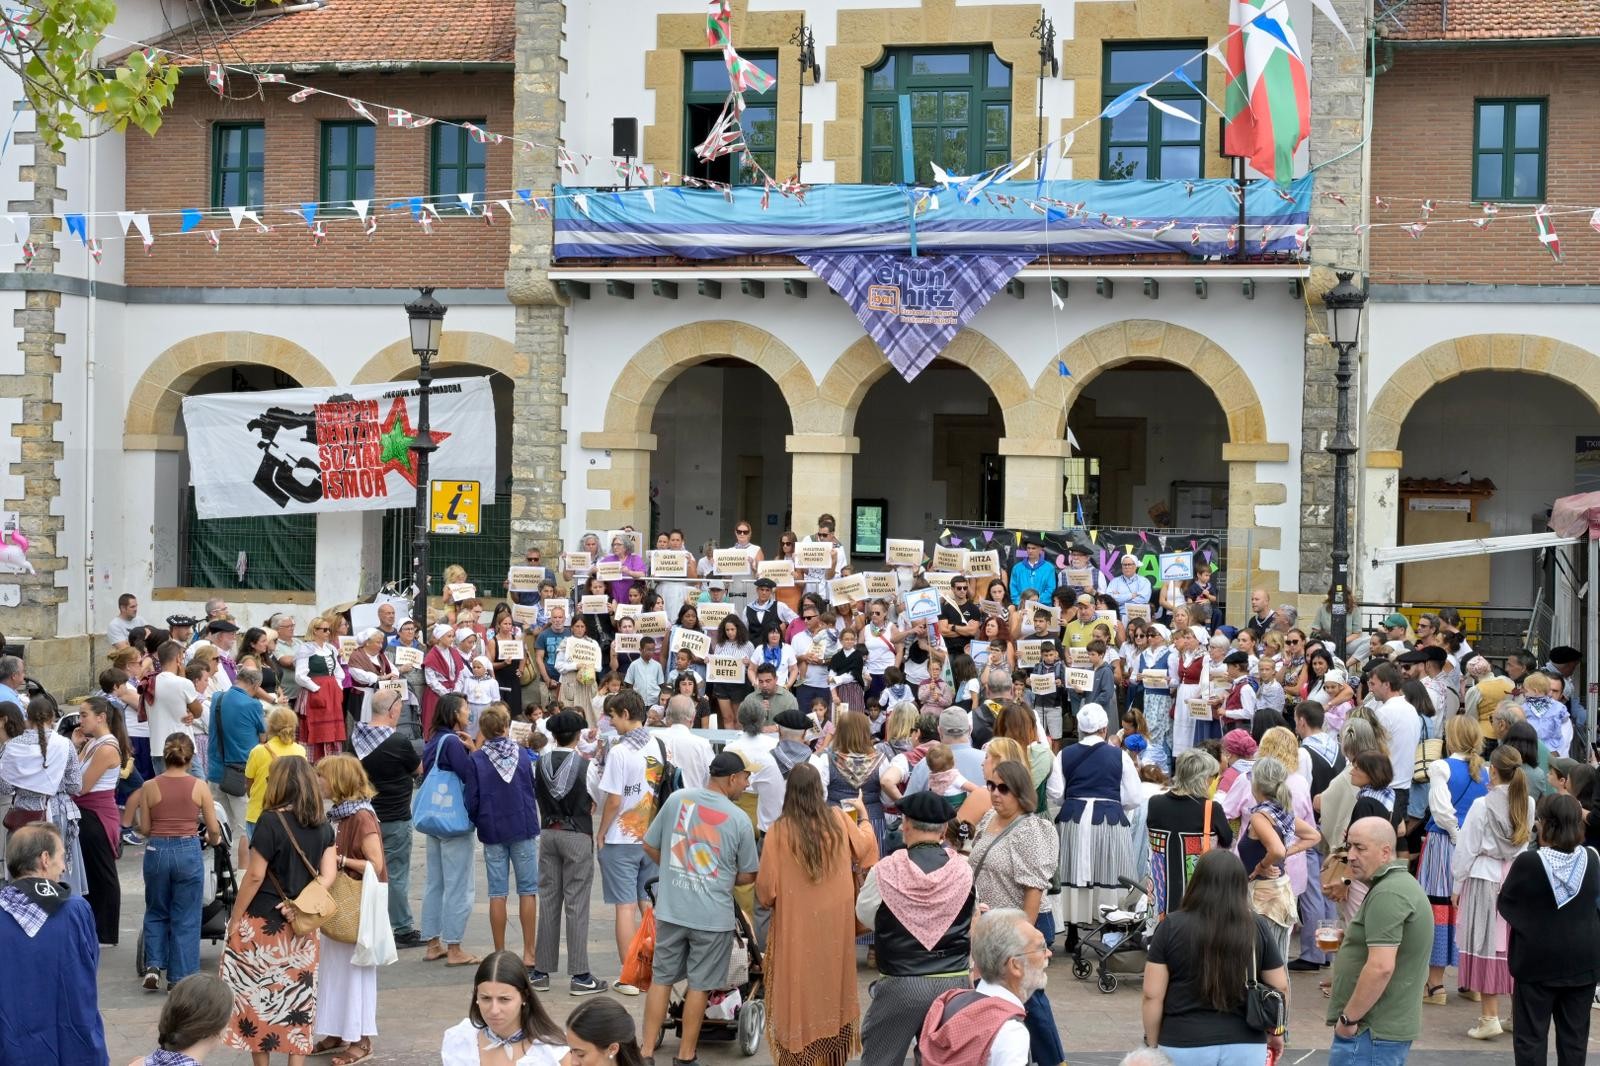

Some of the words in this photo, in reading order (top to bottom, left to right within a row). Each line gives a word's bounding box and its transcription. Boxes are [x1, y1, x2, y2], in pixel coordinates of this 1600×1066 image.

[876, 262, 946, 288] ehun
[900, 285, 955, 308] hitz
[314, 400, 379, 423] INDEPEN
[316, 421, 381, 445] DENTZIA
[319, 443, 385, 471] SOZIAL
[321, 467, 388, 500] ISMOA
[970, 555, 992, 563] HITZA
[971, 563, 992, 572] BETE!
[682, 632, 704, 644] HITZA
[681, 641, 702, 651] BETE!
[715, 659, 738, 668] HITZA
[716, 669, 737, 677] BETE!
[1070, 671, 1089, 679] HITZA
[1070, 679, 1087, 687] BETE!
